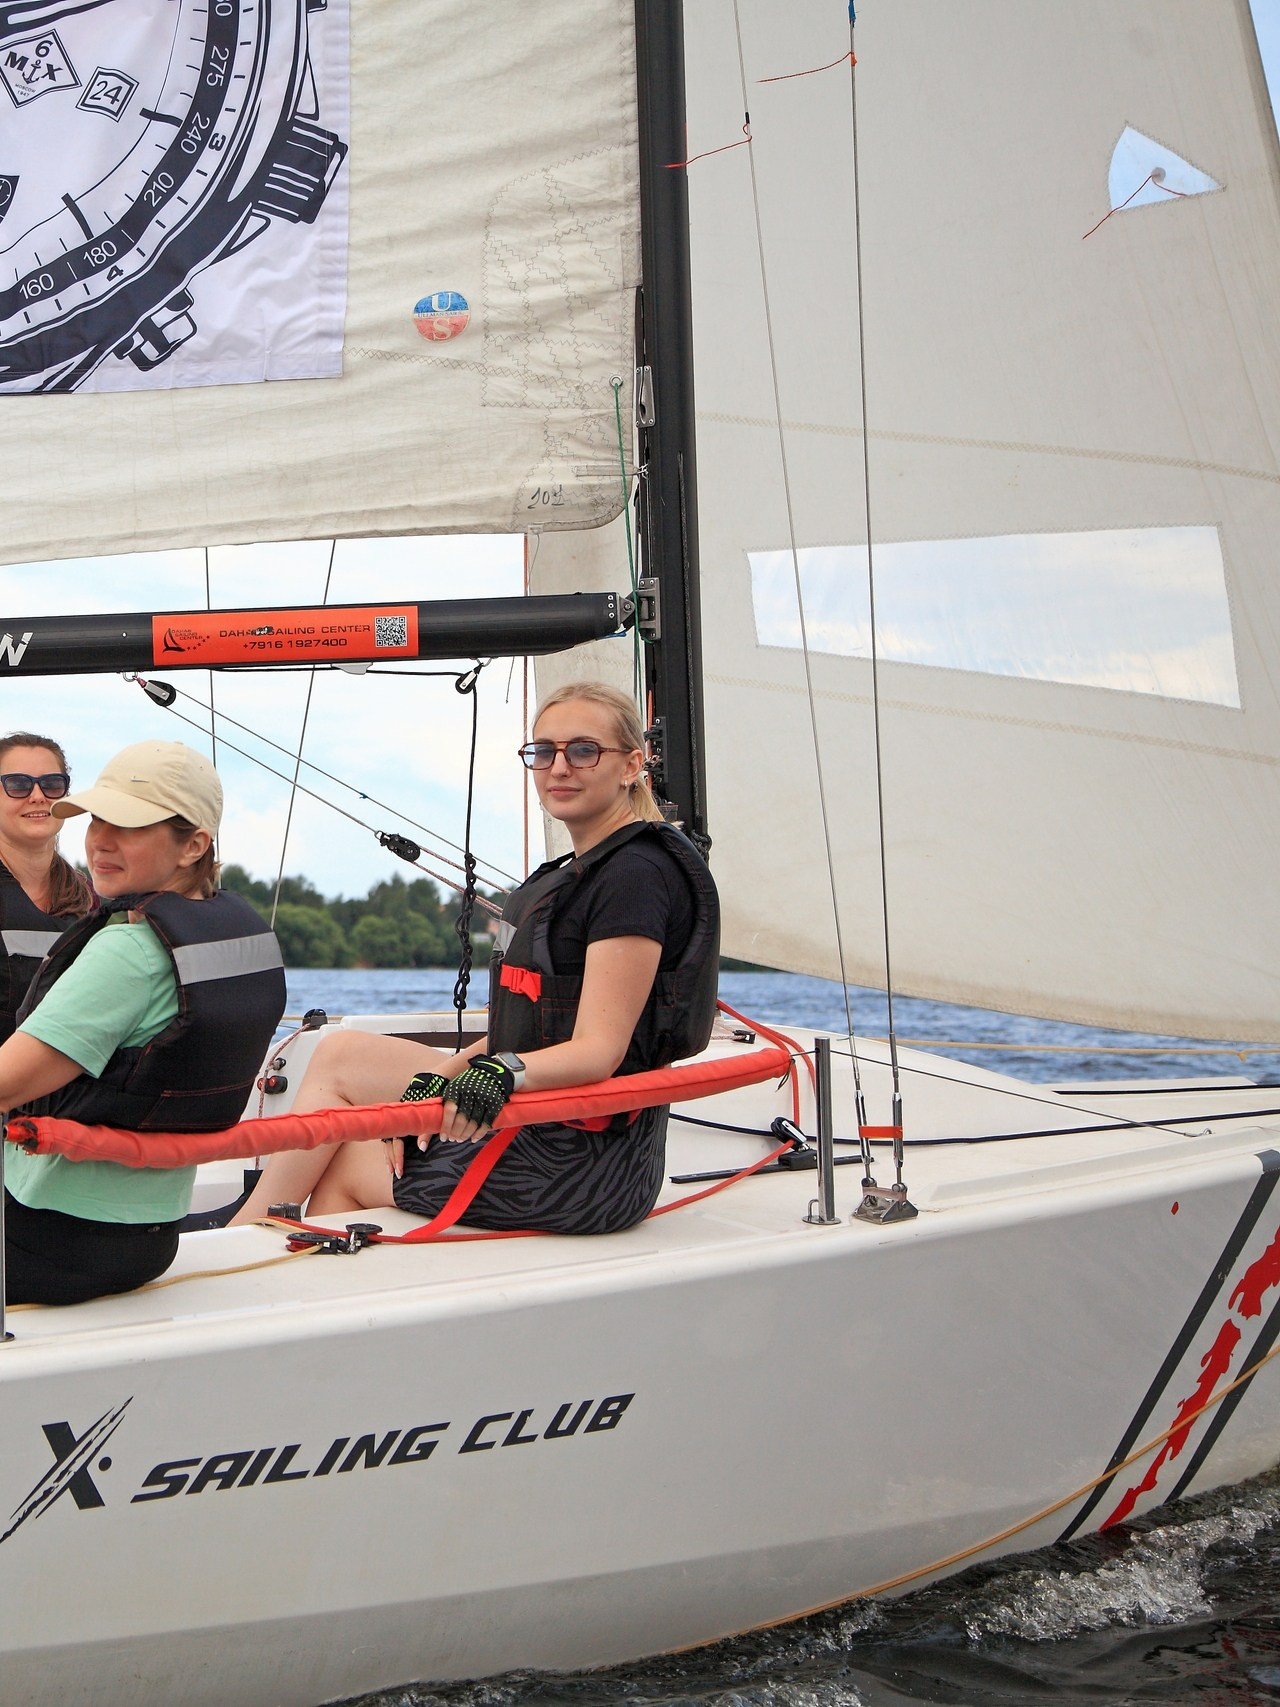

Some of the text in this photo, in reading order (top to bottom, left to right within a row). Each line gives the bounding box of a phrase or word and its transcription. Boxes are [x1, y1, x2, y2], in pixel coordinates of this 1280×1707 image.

[35, 39, 54, 58] 6
[206, 46, 229, 87] 275
[89, 80, 123, 105] 24
[180, 111, 210, 155] 240
[209, 132, 226, 151] 3
[143, 171, 175, 207] 210
[83, 240, 118, 268] 180
[20, 272, 54, 300] 160
[107, 265, 124, 282] 4
[219, 629, 268, 638] DAH
[321, 624, 371, 634] CENTER
[243, 638, 347, 650] +7916 1927400
[130, 1421, 451, 1504] SAILING
[458, 1393, 636, 1455] CLUB
